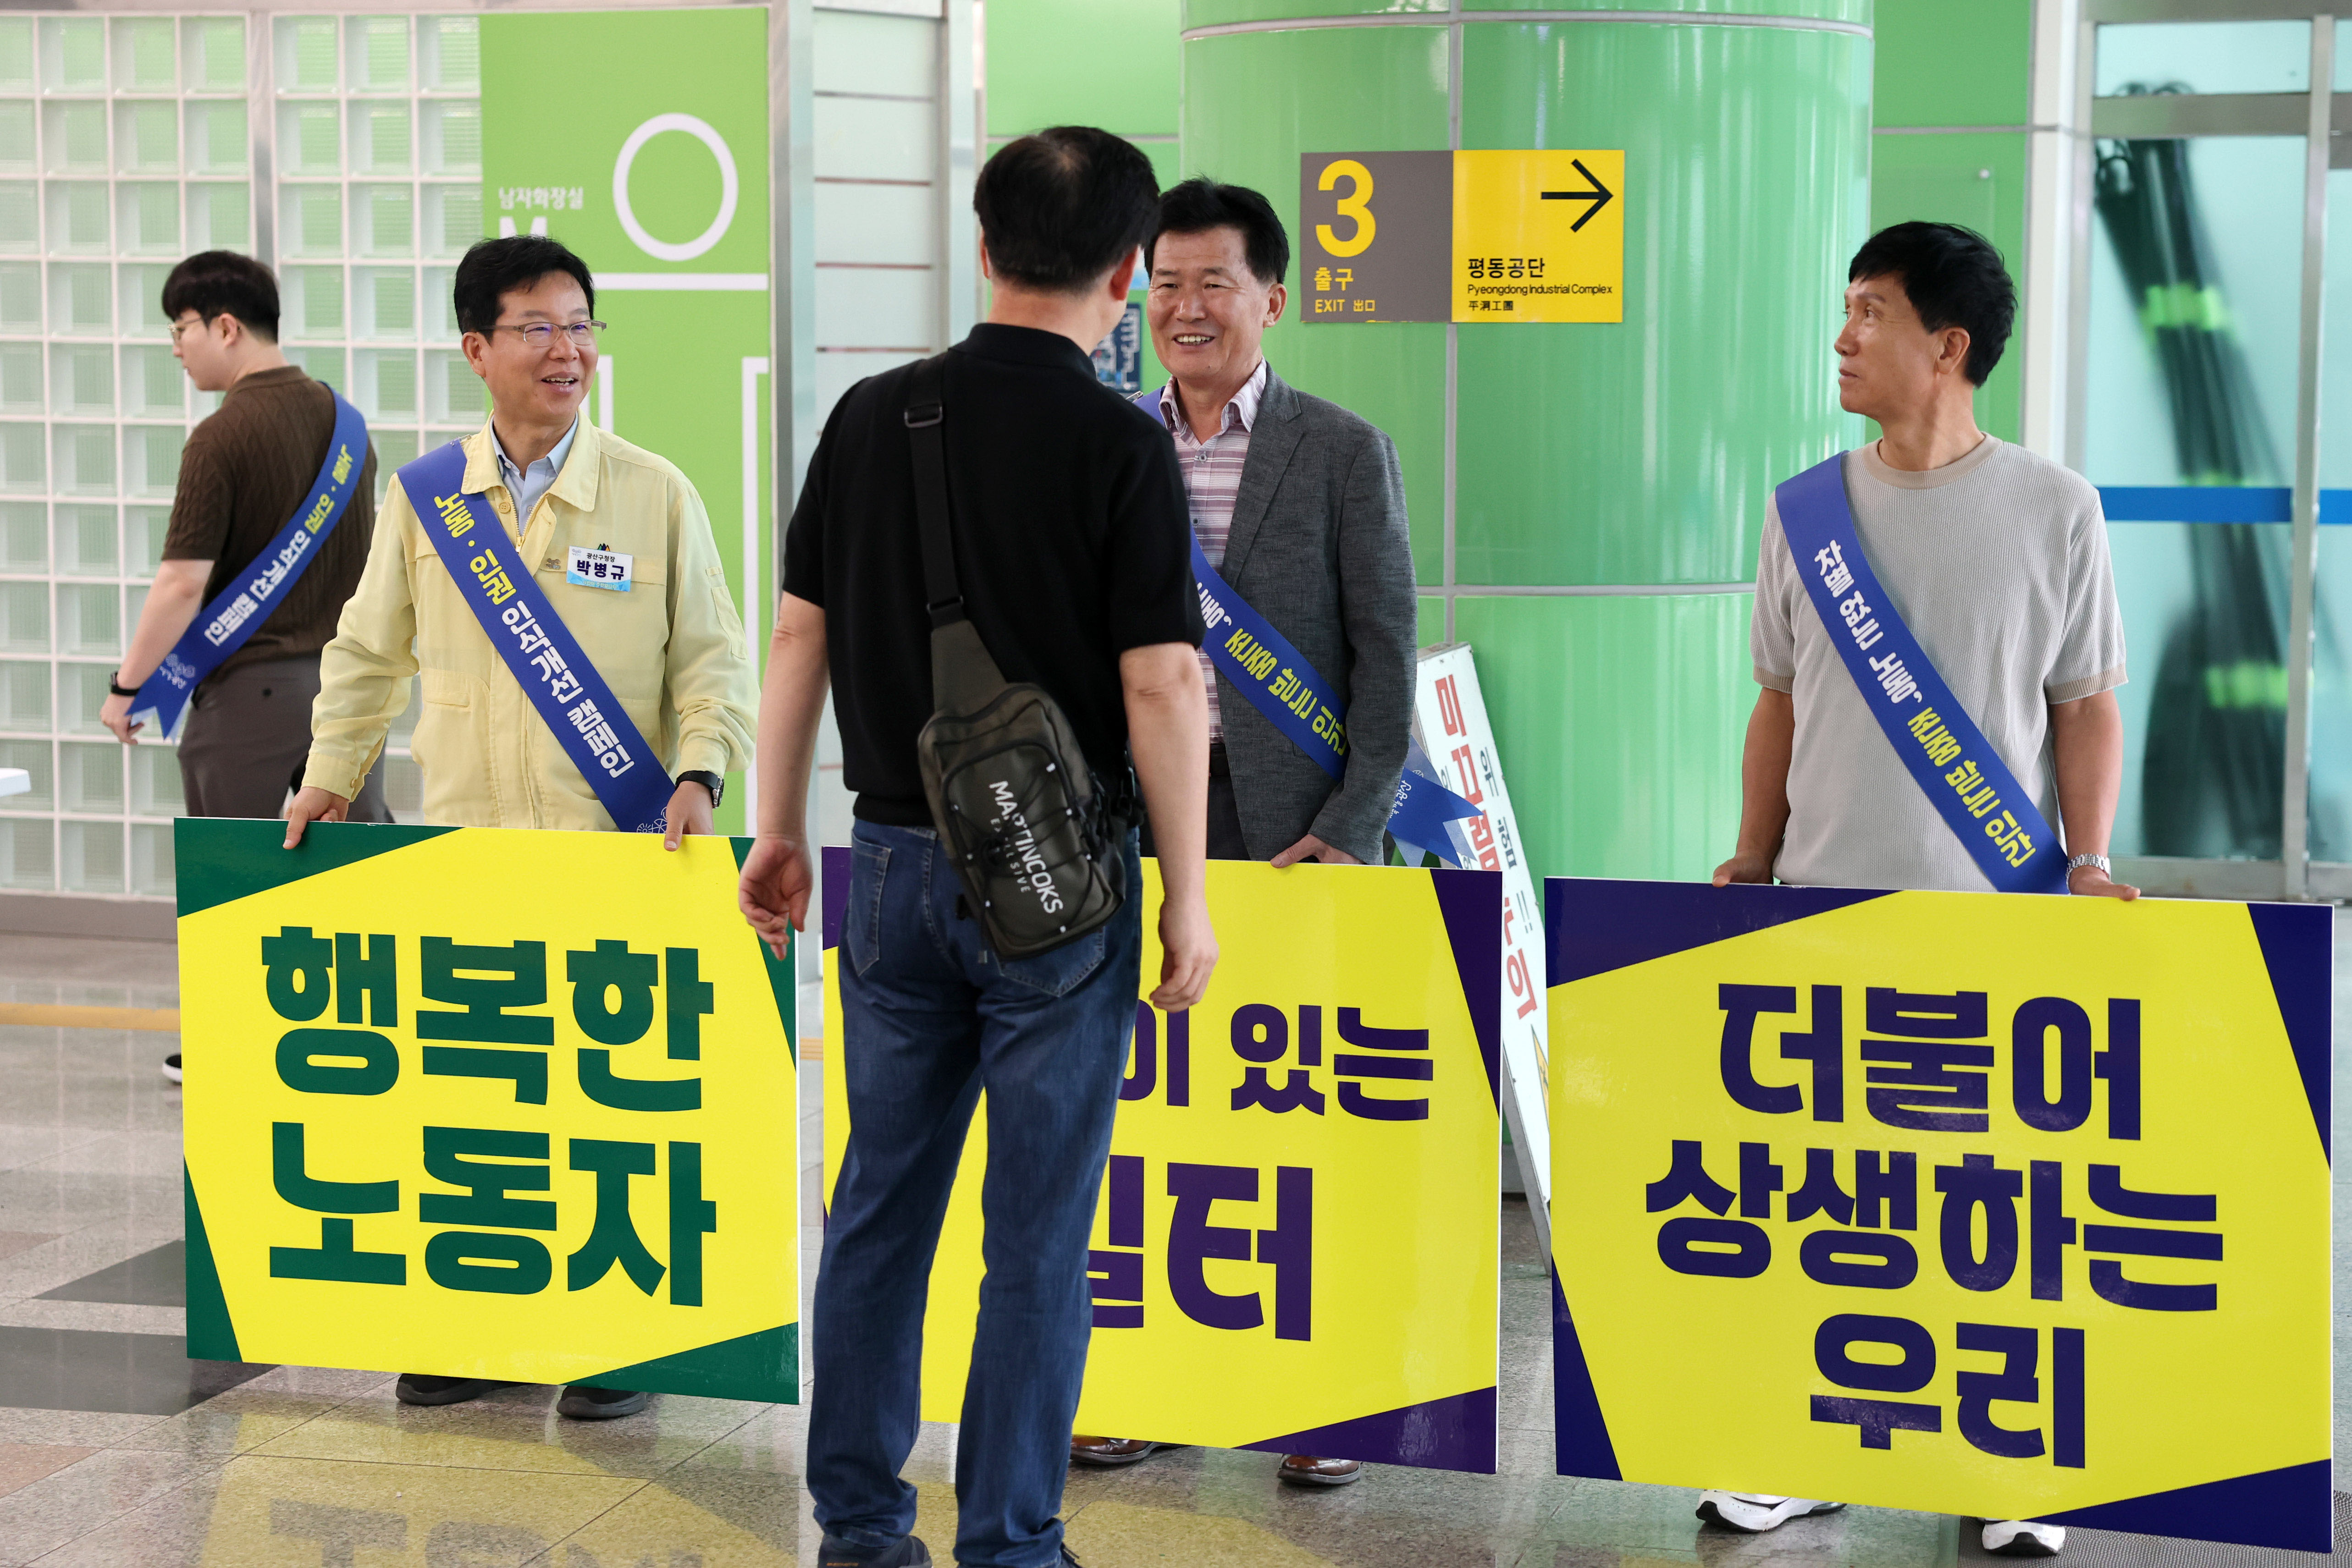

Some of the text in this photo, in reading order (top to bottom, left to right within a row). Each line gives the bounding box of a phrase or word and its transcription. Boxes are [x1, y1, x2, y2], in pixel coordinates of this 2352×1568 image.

[498, 187, 584, 210] 남자화장실
[1315, 159, 1376, 258] 3
[1314, 267, 1354, 292] 출구
[1314, 299, 1375, 314] EXIT 出口
[1468, 258, 1546, 279] 평동공단
[1468, 284, 1612, 296] Pyeongdong Industrial Complex
[305, 493, 334, 534] 인권
[586, 553, 615, 562] 광산구청장
[250, 530, 310, 601] 인식개선
[204, 593, 258, 646] 캠페인
[433, 492, 475, 538] 노동
[470, 548, 516, 605] 인권
[502, 600, 584, 704] 인식개선
[567, 698, 634, 778] 캠페인
[1224, 628, 1277, 680] 존중
[1268, 668, 1317, 719] 받는
[1814, 539, 1854, 598] 차별
[1839, 590, 1883, 650] 없는
[1907, 707, 1961, 766] 존중
[1944, 759, 2000, 818] 받는
[1985, 809, 2036, 868] 인간
[261, 926, 714, 1112] 행복한
[1231, 1003, 1433, 1121] 있는
[1718, 983, 2141, 1141] 더불어
[270, 1122, 717, 1307] 노동자
[1645, 1139, 2223, 1312] 상생하는
[1810, 1313, 2085, 1469] 우리
